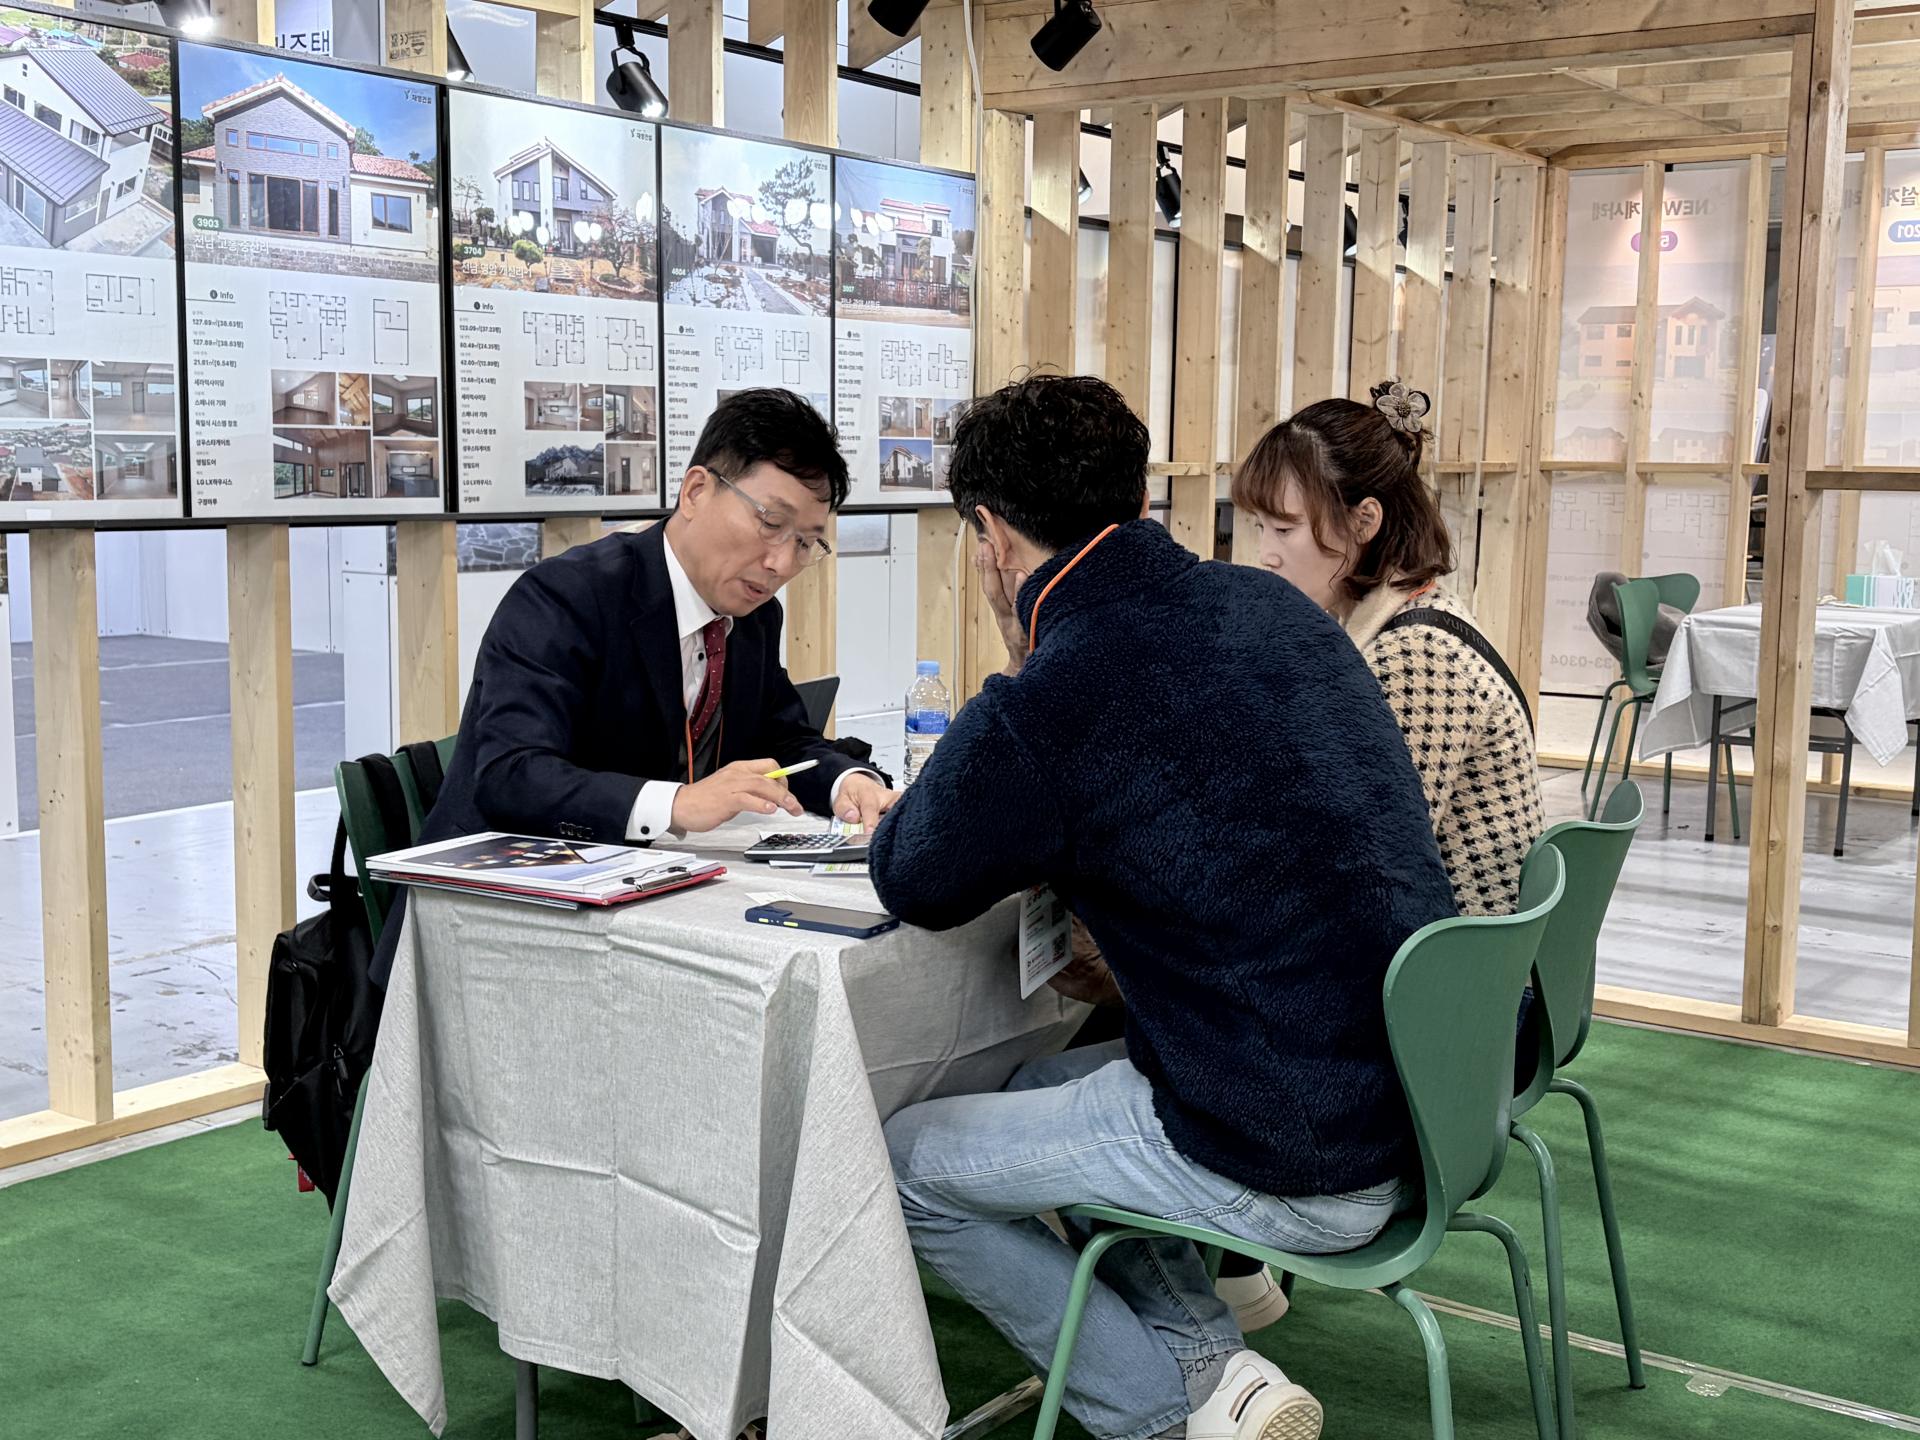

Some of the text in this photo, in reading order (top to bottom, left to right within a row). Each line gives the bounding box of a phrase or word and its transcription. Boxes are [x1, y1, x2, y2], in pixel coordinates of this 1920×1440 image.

[197, 217, 220, 228] 3903
[463, 246, 482, 255] 3704
[220, 291, 234, 299] Info
